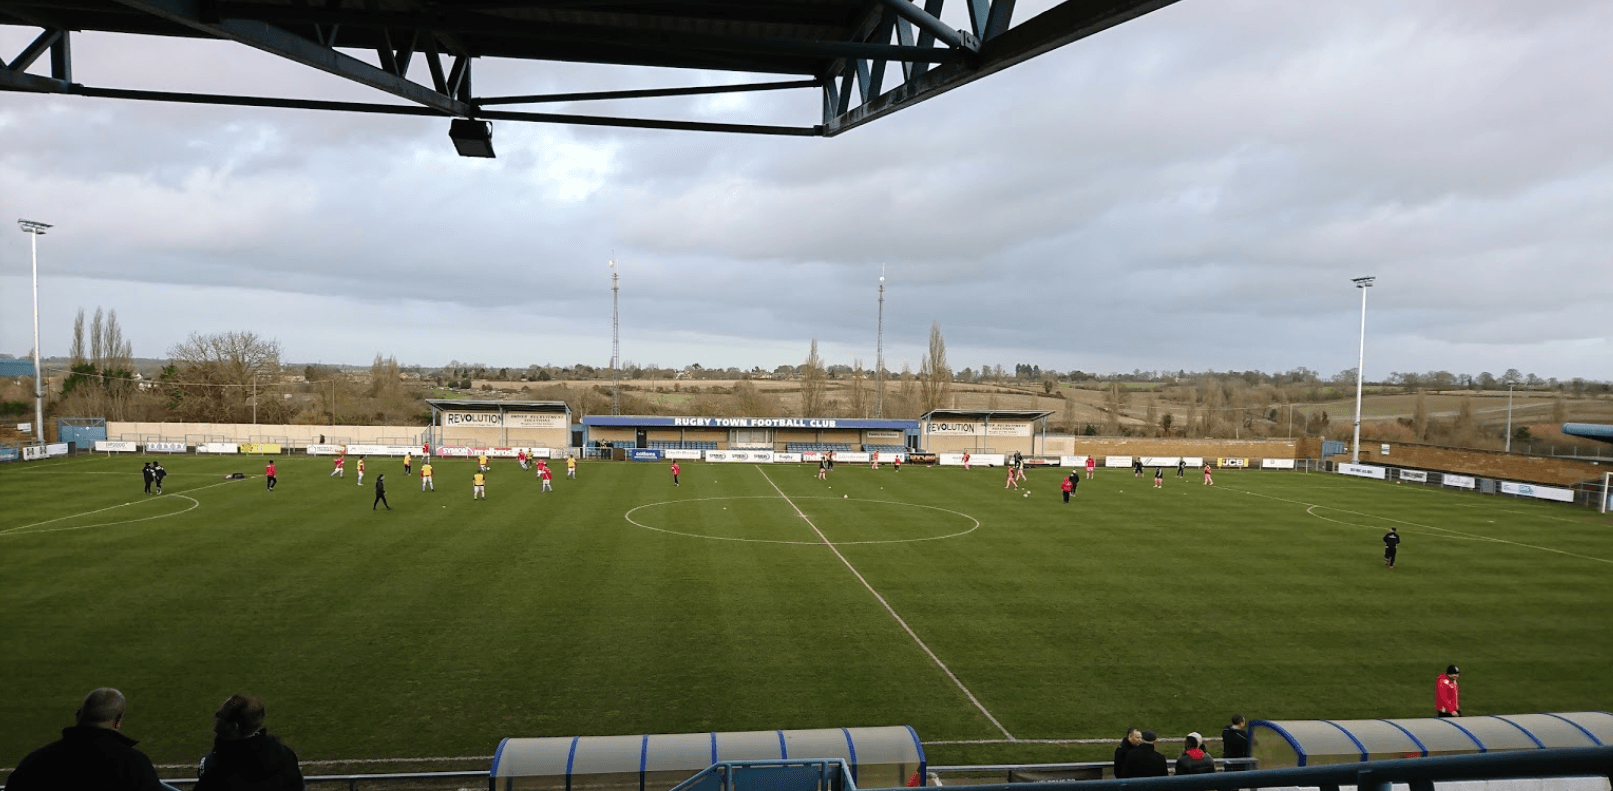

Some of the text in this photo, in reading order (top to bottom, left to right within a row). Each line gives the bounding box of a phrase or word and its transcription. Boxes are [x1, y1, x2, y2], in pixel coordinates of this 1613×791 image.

[448, 413, 503, 424] REVOLUTION
[674, 417, 836, 428] RUGBY TOWN FOOTBALL CLUB
[926, 423, 975, 433] REVOLUTION
